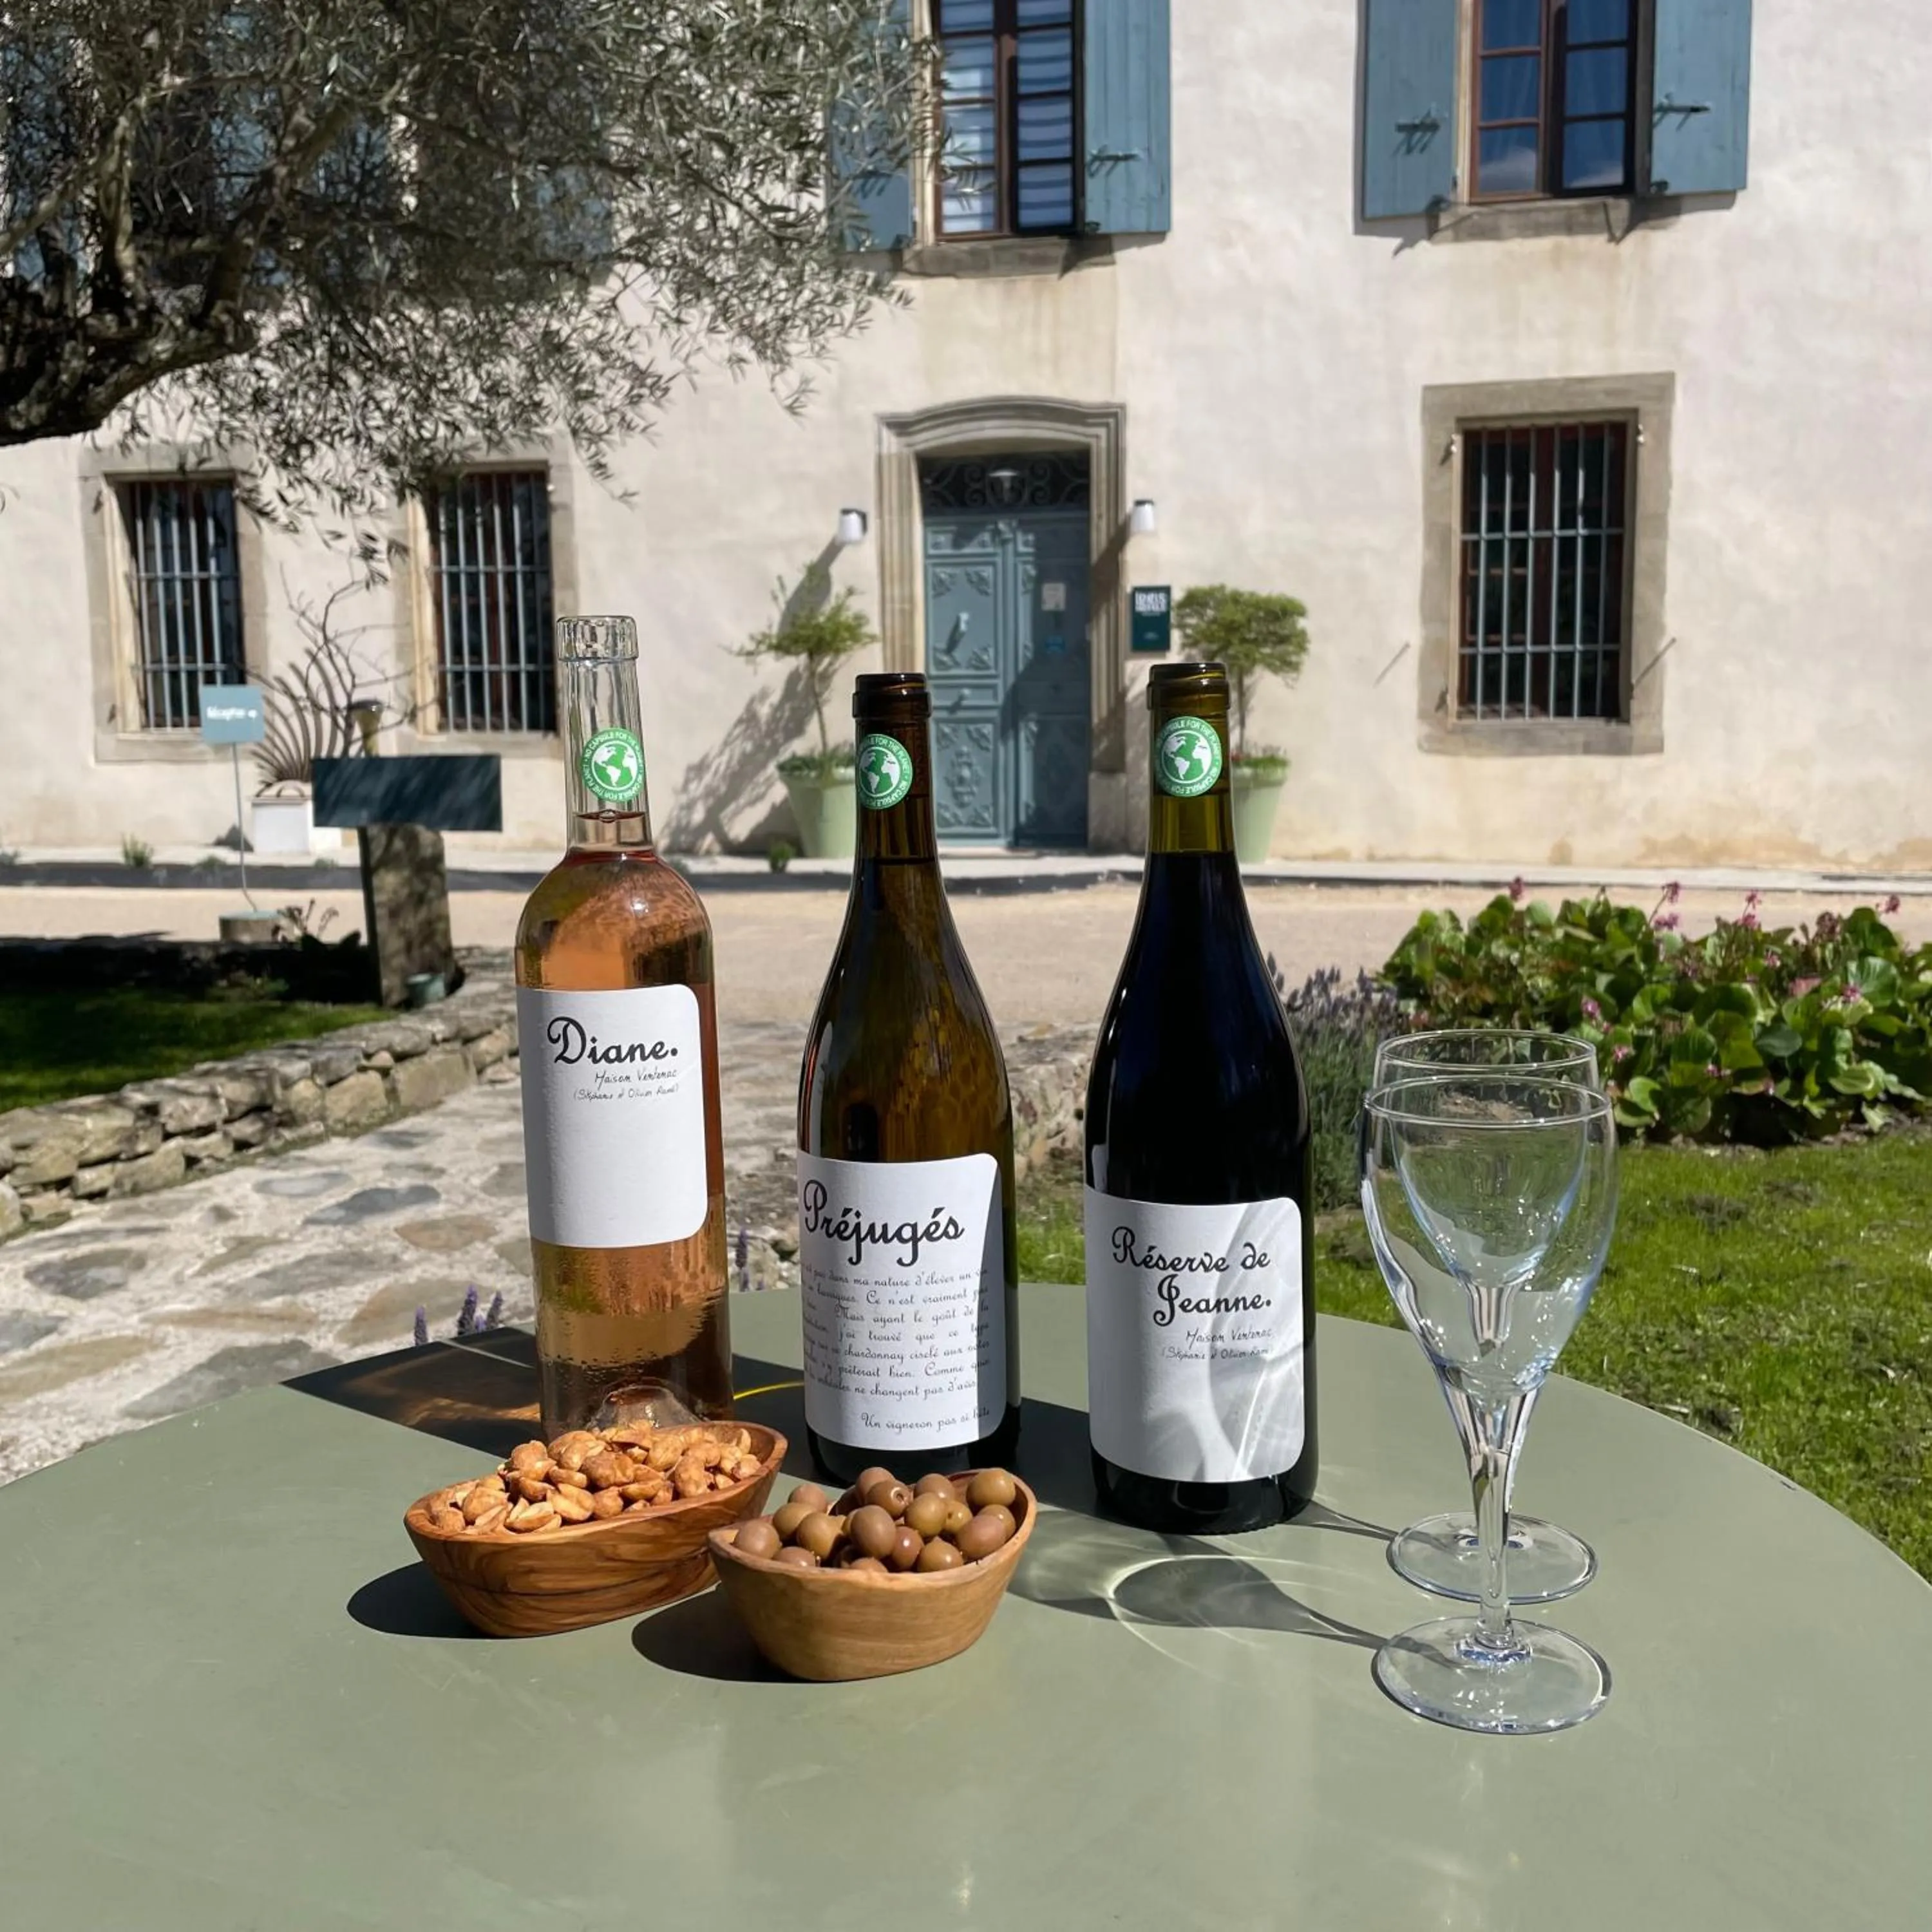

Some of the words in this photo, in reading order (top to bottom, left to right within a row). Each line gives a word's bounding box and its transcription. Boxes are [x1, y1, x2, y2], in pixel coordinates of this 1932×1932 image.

[547, 1016, 678, 1065] Diane.
[594, 1069, 632, 1091] Maison
[803, 1179, 965, 1267] Préjugés
[1112, 1226, 1229, 1273] Réserve
[1240, 1241, 1271, 1270] de
[853, 1278, 869, 1287] ma
[874, 1277, 910, 1287] nature
[958, 1273, 971, 1281] un
[866, 1289, 881, 1305] Ce
[888, 1289, 914, 1305] n'est
[922, 1287, 967, 1303] vraiment
[1153, 1273, 1272, 1327] Jeanne.
[834, 1298, 865, 1322] Mais
[873, 1312, 905, 1329] ayant
[914, 1309, 923, 1323] le
[931, 1308, 956, 1327] goût
[963, 1304, 974, 1316] de
[980, 1298, 990, 1312] la
[868, 1329, 902, 1342] trouvé
[915, 1332, 935, 1345] que
[948, 1329, 958, 1338] ce
[1185, 1327, 1226, 1350] Maison
[844, 1343, 904, 1365] chardonnay
[924, 1361, 964, 1376] Comme
[870, 1382, 920, 1402] changent
[923, 1386, 944, 1401] pas
[861, 1412, 881, 1429] Un
[886, 1420, 933, 1435] vigneron
[938, 1417, 957, 1433] pas
[960, 1412, 969, 1423] si
